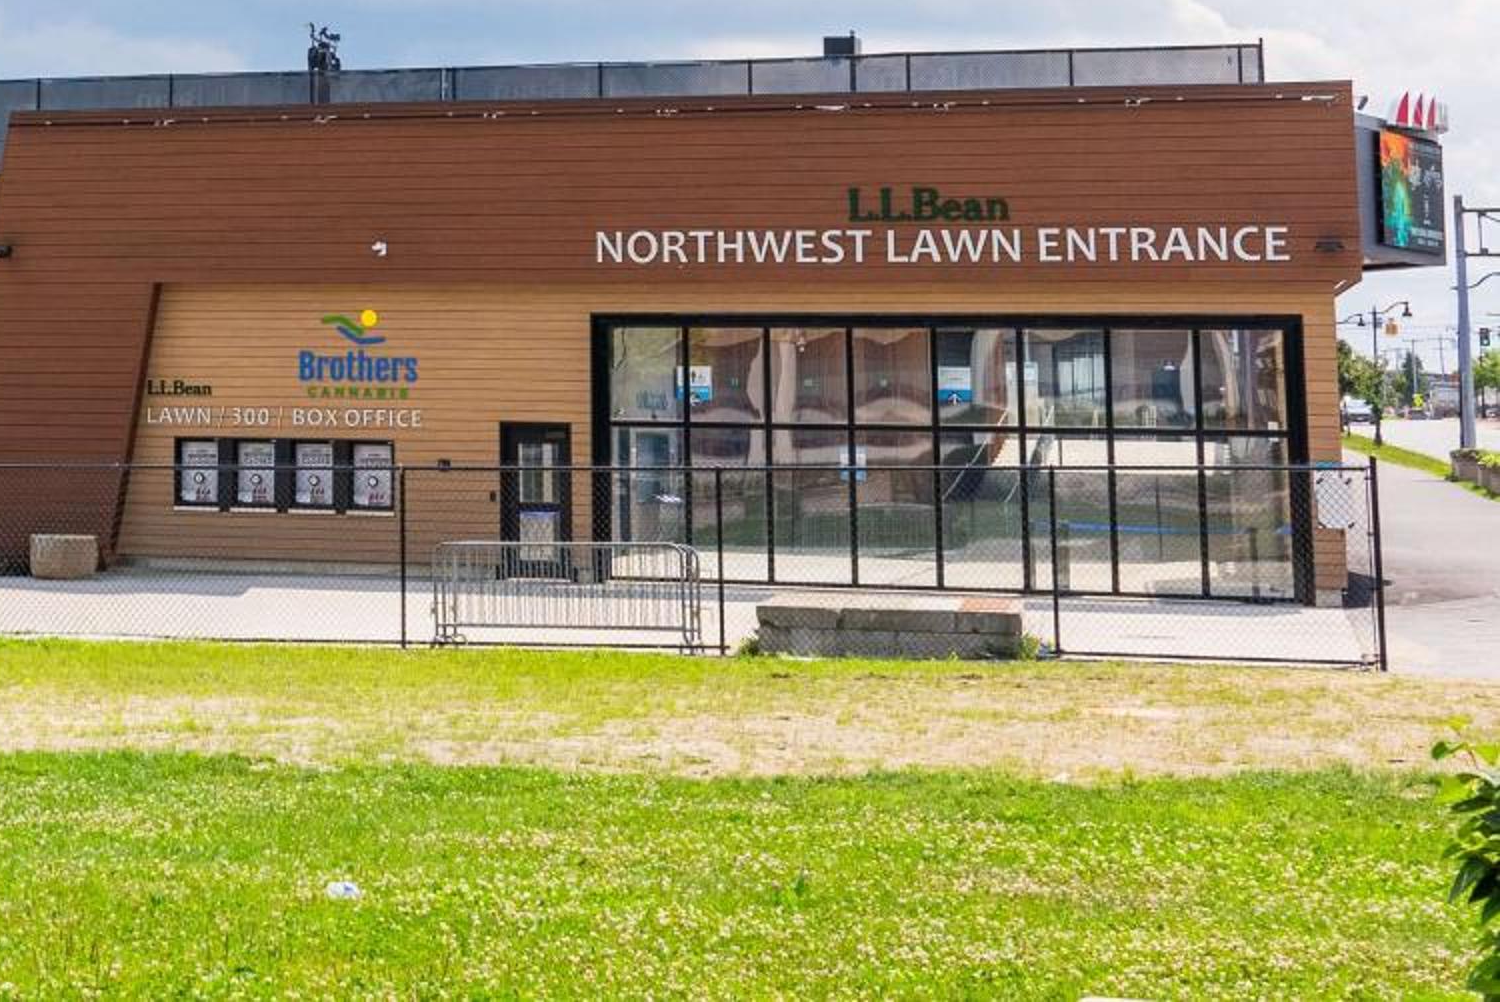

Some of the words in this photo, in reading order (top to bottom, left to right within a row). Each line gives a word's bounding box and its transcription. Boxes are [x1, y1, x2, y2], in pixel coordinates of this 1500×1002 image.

[848, 188, 1010, 222] L.L.Bean
[596, 230, 872, 265] NORTHWEST
[886, 228, 1023, 264] LAWN
[1039, 226, 1292, 263] ENTRANCE
[298, 351, 418, 383] Brothers
[147, 380, 212, 396] L.L.Bean
[307, 385, 410, 399] CANNABIS
[147, 407, 212, 424] LAWN
[231, 408, 270, 425] 300
[293, 409, 338, 426] BOX
[345, 409, 422, 427] OFFICE
